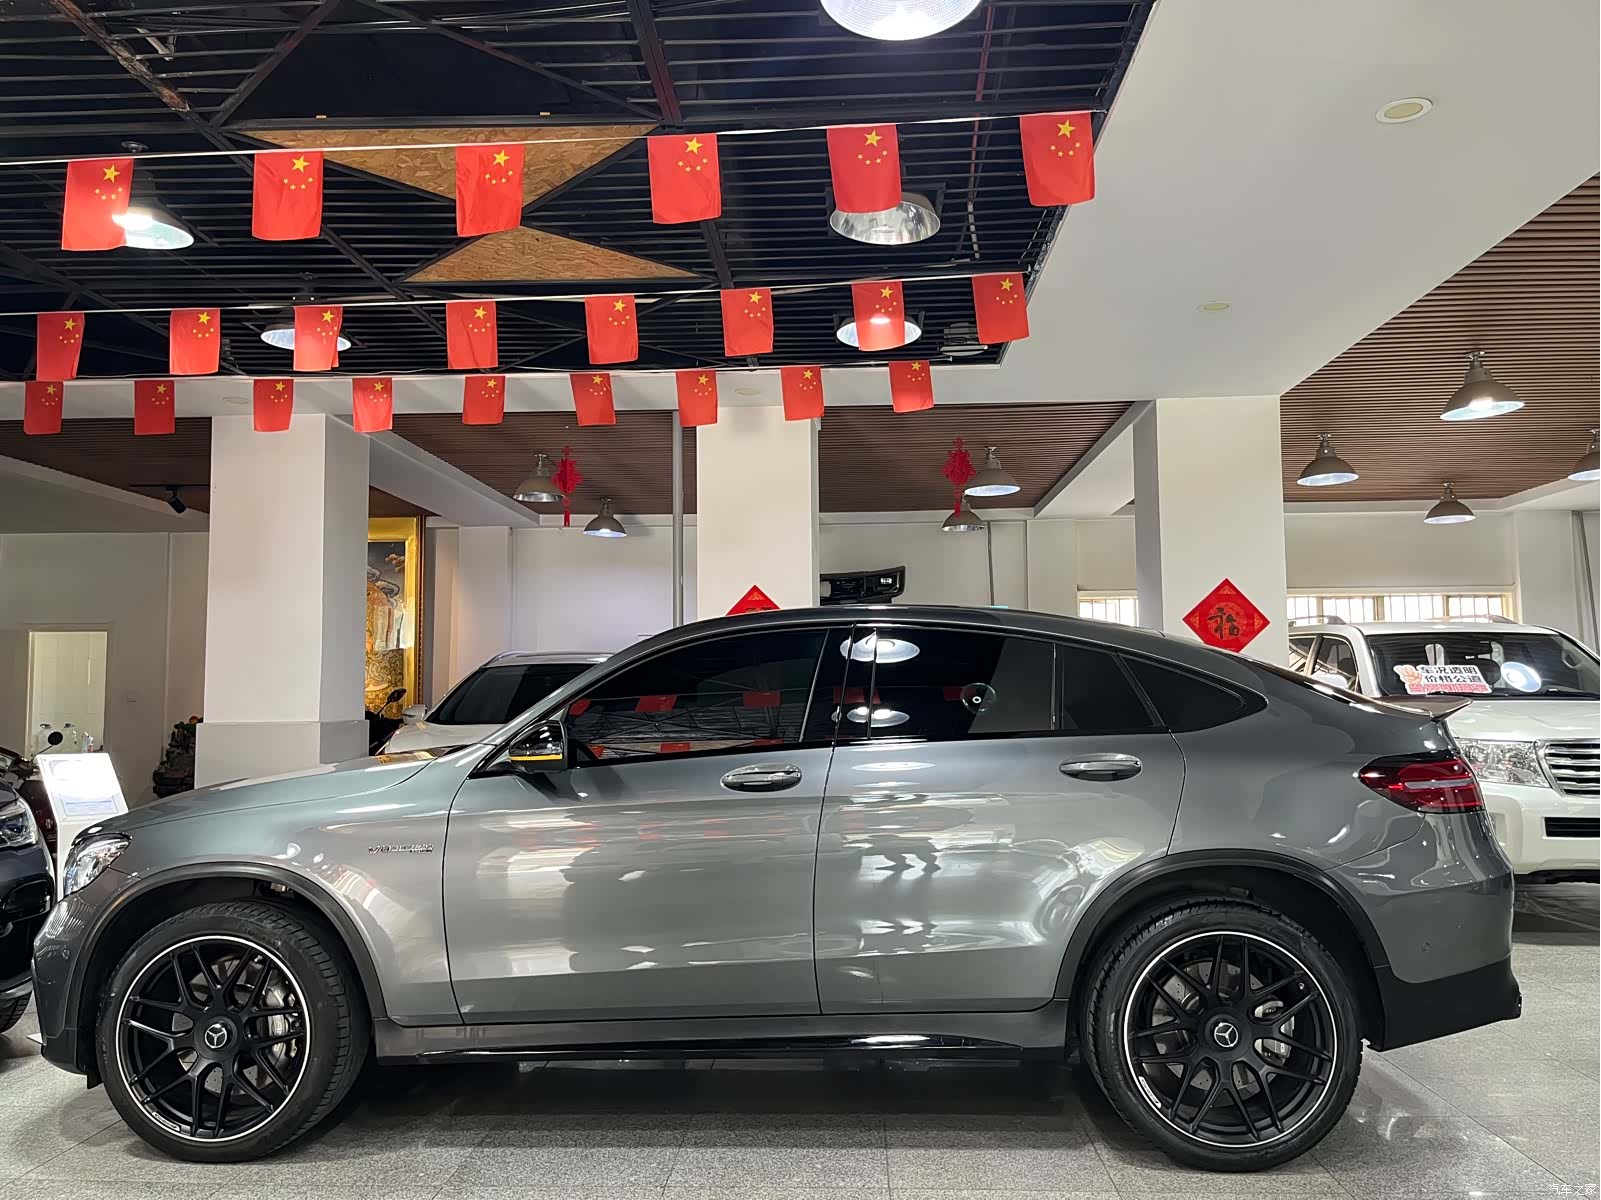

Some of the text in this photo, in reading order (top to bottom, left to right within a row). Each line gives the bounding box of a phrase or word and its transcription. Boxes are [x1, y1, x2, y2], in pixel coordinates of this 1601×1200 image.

[1207, 607, 1240, 639] 福
[1420, 666, 1477, 674] 车况透明
[1425, 675, 1482, 683] 价格公道
